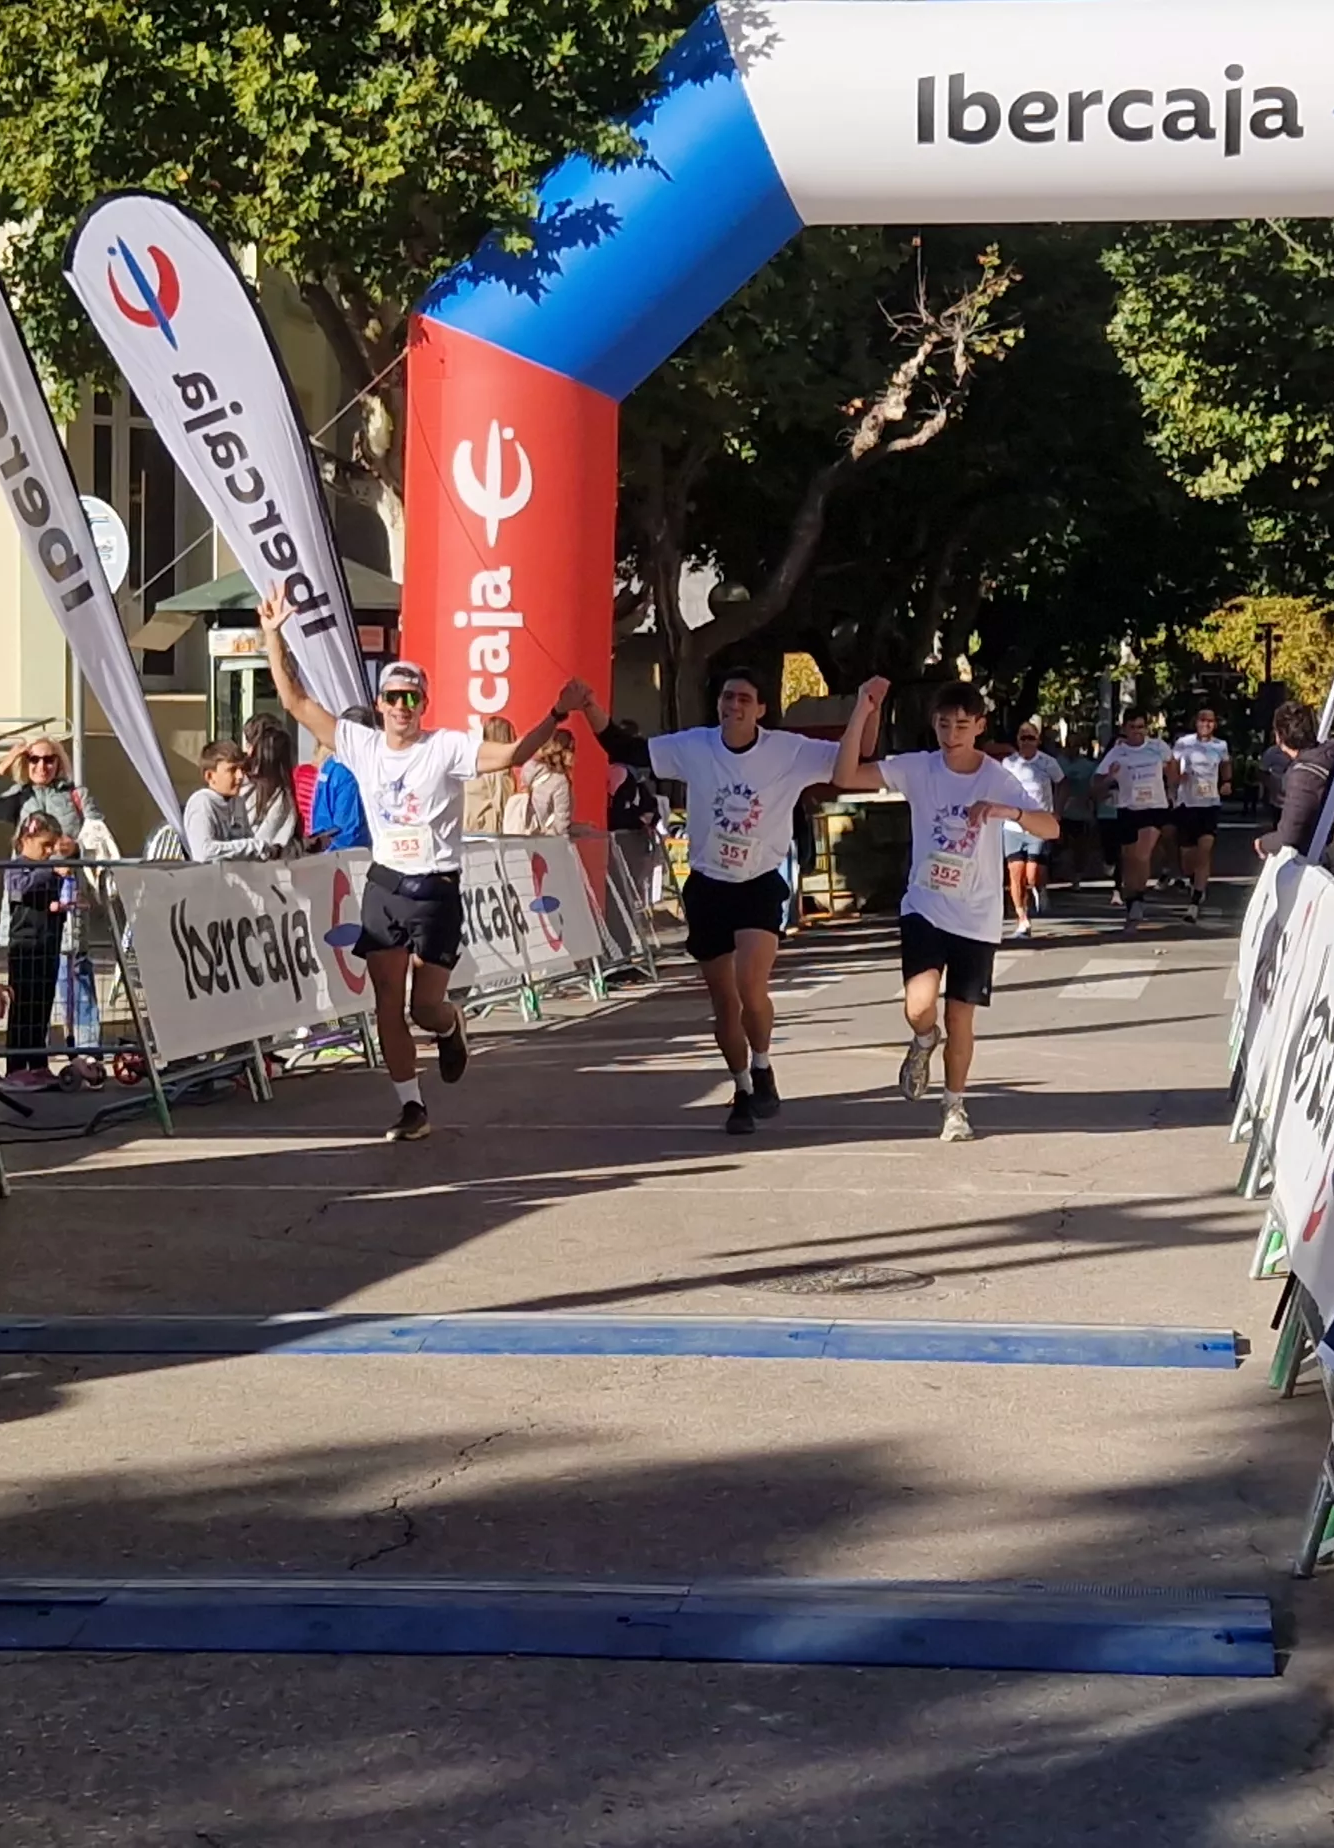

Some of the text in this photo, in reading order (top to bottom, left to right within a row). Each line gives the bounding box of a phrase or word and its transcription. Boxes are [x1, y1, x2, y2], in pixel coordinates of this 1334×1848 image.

[916, 64, 1305, 157] Ibercaja
[392, 839, 420, 852] 353
[719, 843, 749, 861] 351
[930, 863, 961, 882] 352
[170, 884, 319, 1002] Ibercaja
